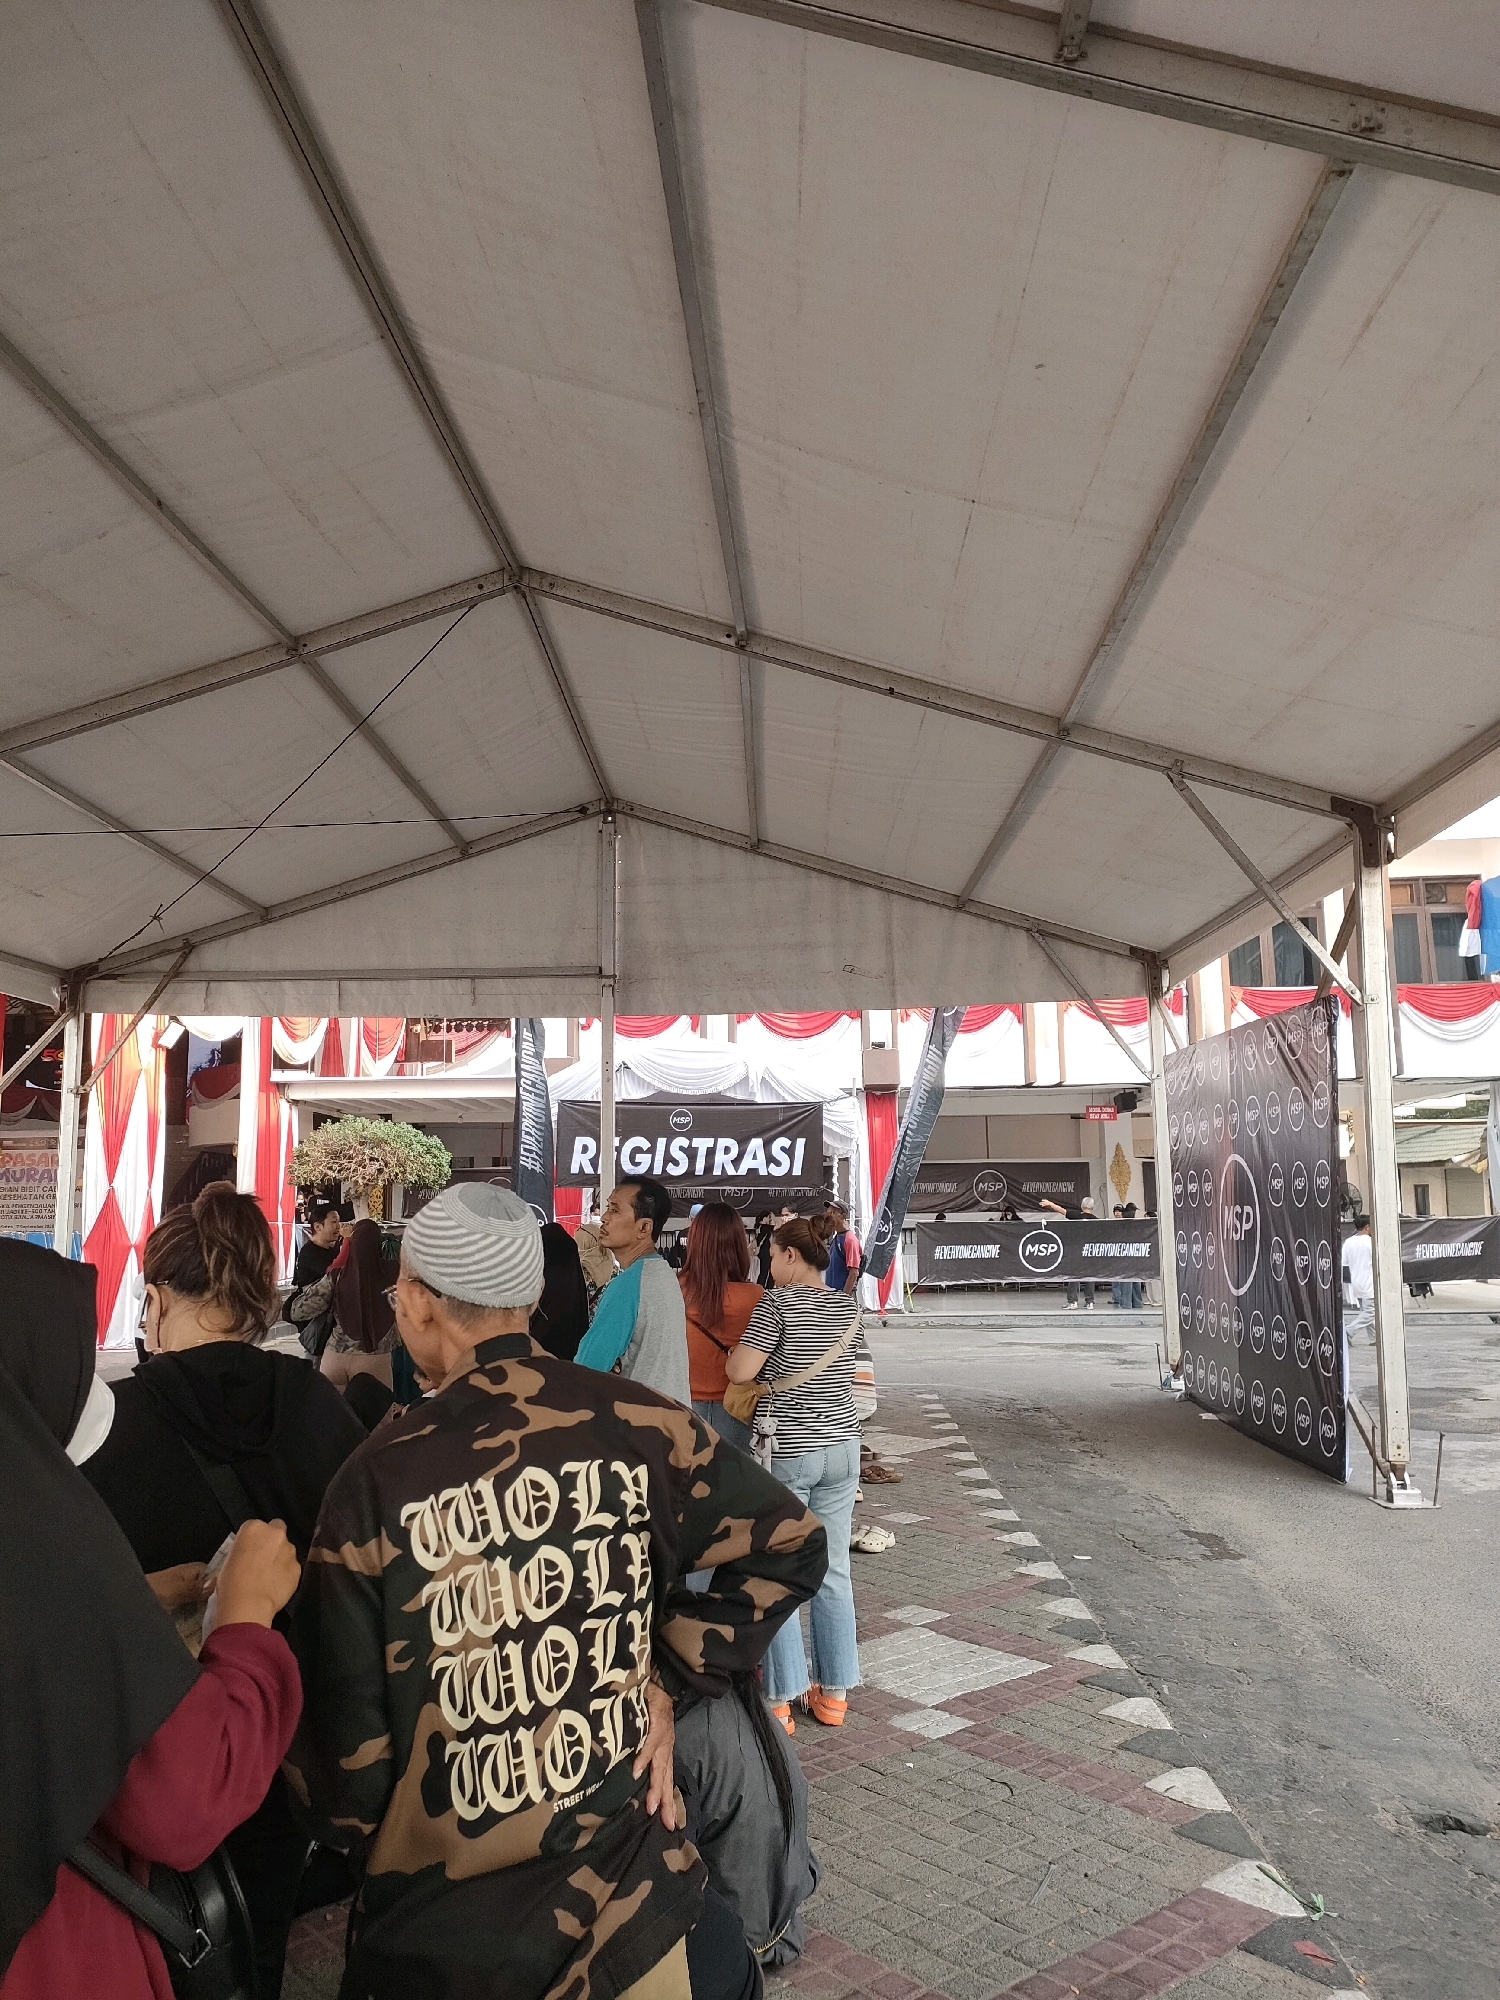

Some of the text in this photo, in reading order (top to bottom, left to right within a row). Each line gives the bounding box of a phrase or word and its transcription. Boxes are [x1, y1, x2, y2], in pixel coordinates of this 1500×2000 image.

[1288, 1030, 1302, 1044] MSP
[1314, 1021, 1328, 1037] MSP
[1247, 1109, 1259, 1121] MSP
[1268, 1105, 1279, 1118] MSP
[1291, 1102, 1302, 1115] MSP
[1314, 1097, 1328, 1111] MSP
[673, 1116, 691, 1124] MSP
[0, 1168, 57, 1182] MURA
[1271, 1178, 1283, 1190] MSP
[1294, 1177, 1306, 1189] MSP
[1316, 1176, 1330, 1189] MSP
[978, 1182, 1003, 1192] MSP
[1223, 1204, 1254, 1241] MSP
[934, 1241, 1484, 1260] #EVERYONECANGIVE MSP #EVERYONECANGIVE #EVERYONECANGIVE
[1272, 1252, 1283, 1265] MSP
[1319, 1258, 1331, 1271] MSP
[1251, 1326, 1264, 1338] MSP
[1273, 1330, 1285, 1344] MSP
[1297, 1337, 1311, 1350] MSP
[1252, 1395, 1264, 1408] MSP
[1273, 1403, 1285, 1417] MSP
[1297, 1415, 1310, 1429] MSP
[553, 1790, 585, 1813] STREET
